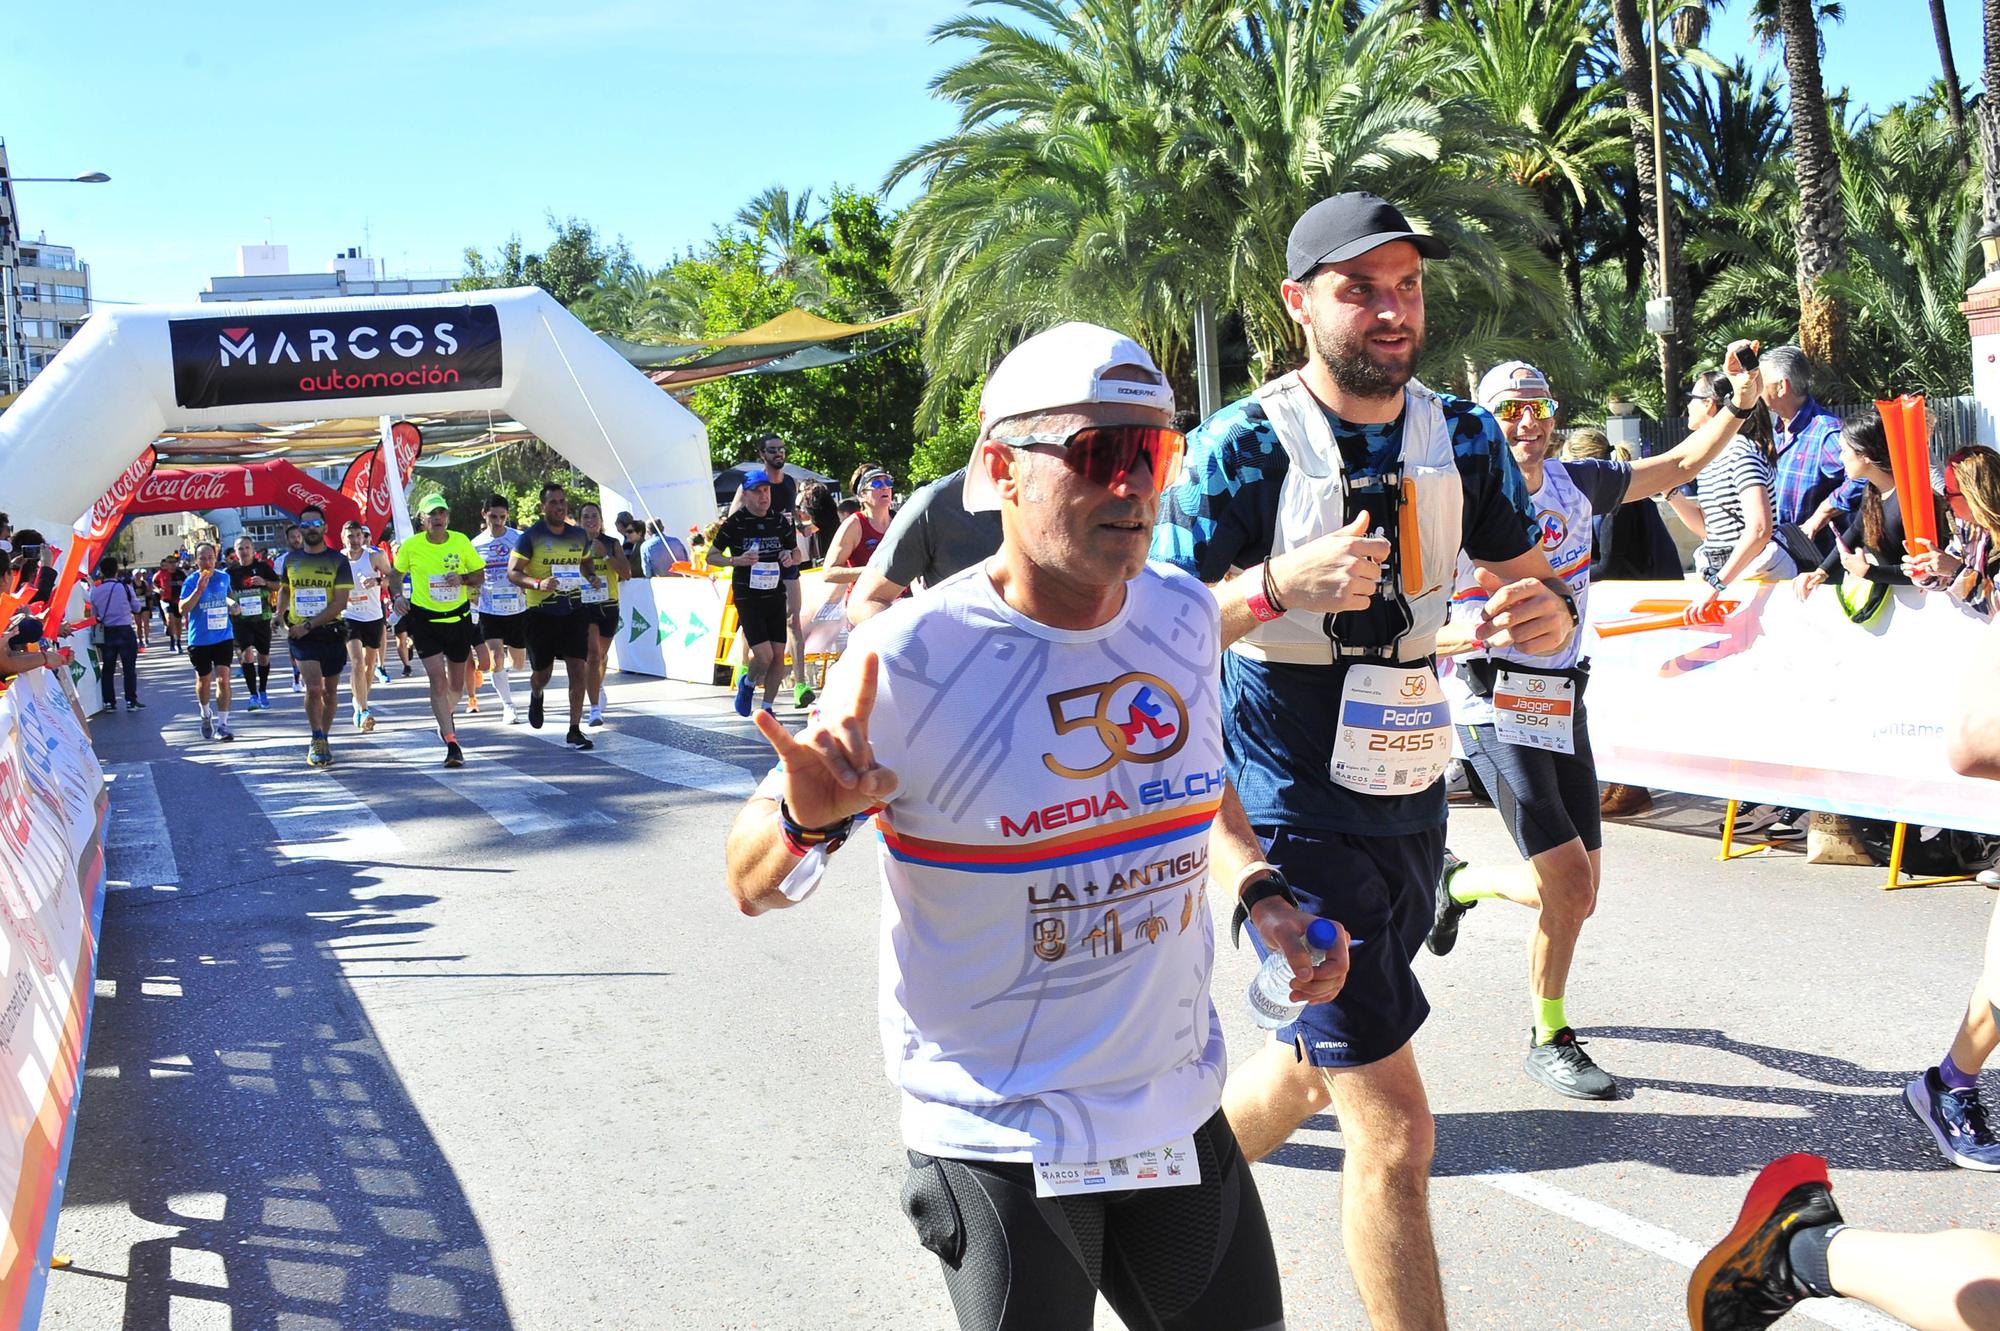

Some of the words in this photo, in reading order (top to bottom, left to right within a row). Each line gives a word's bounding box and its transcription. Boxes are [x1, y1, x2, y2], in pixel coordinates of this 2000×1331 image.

[219, 323, 458, 367] MARCOS
[300, 364, 459, 392] automoción
[136, 472, 229, 503] Coca-Cola
[1512, 698, 1555, 713] Jagger
[1042, 671, 1190, 780] 50
[1382, 709, 1432, 726] Pedro
[1515, 714, 1549, 728] 994
[1368, 733, 1435, 752] 2455
[1000, 790, 1129, 838] MEDIA
[1028, 883, 1075, 905] LA
[1315, 1041, 1348, 1049] ARTENGO
